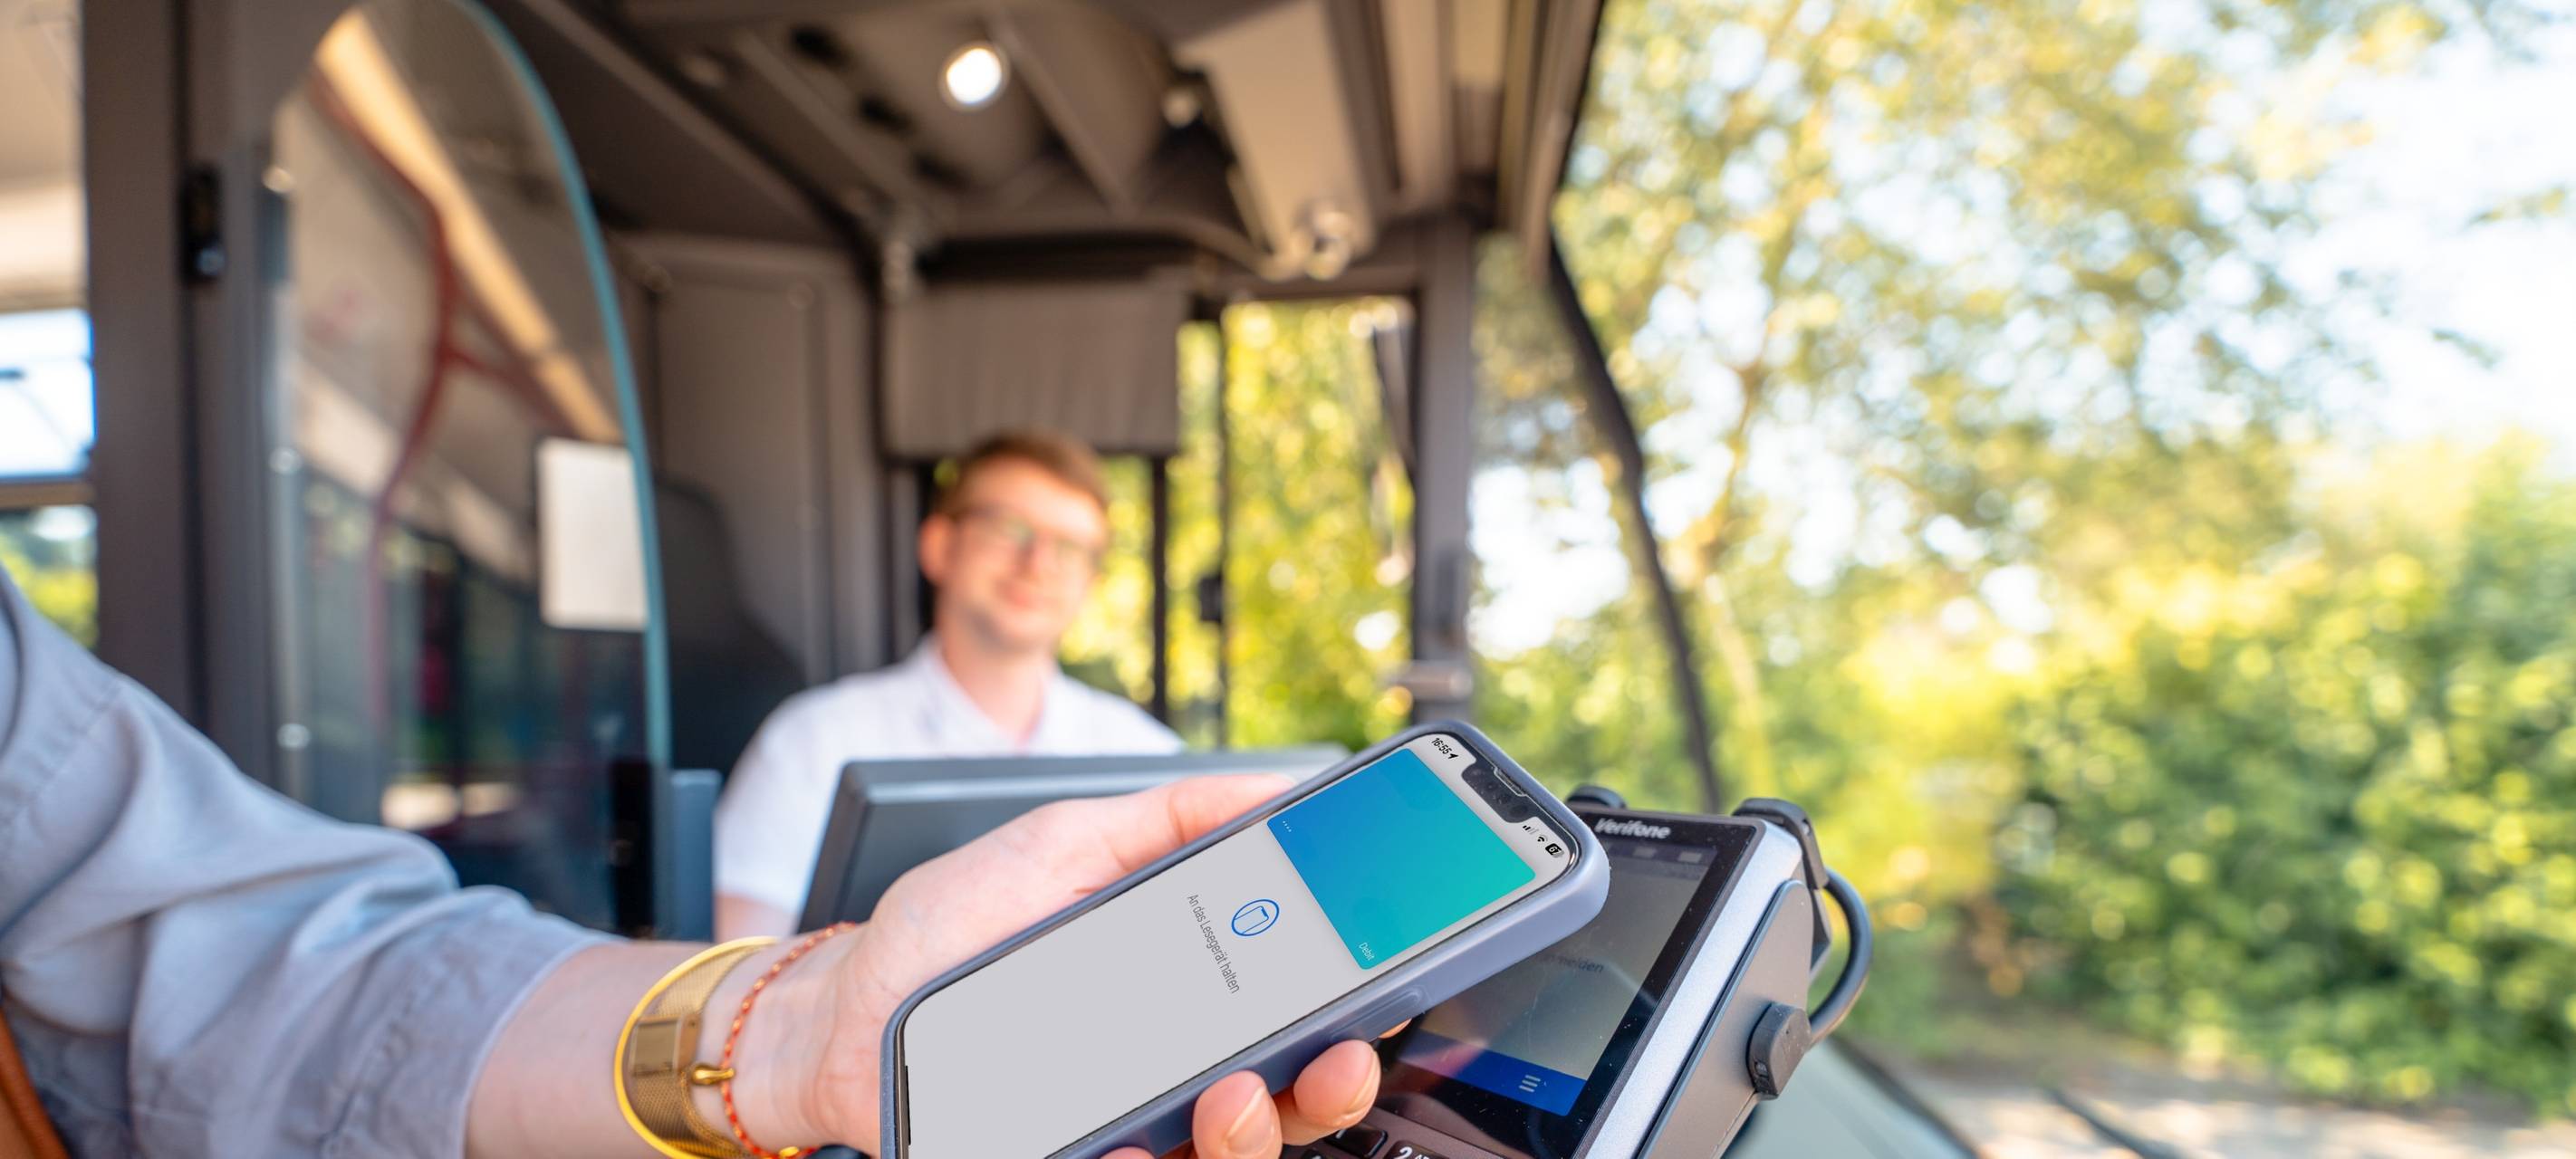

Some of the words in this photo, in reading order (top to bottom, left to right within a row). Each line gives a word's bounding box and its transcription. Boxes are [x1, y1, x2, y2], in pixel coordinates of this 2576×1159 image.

[1431, 738, 1452, 754] 16:55
[1594, 818, 1671, 839] Verifone
[1187, 895, 1199, 906] An
[1192, 907, 1206, 923] das
[1200, 920, 1229, 964] Lesegerät
[1359, 942, 1375, 962] Debit
[1219, 962, 1240, 994] halten
